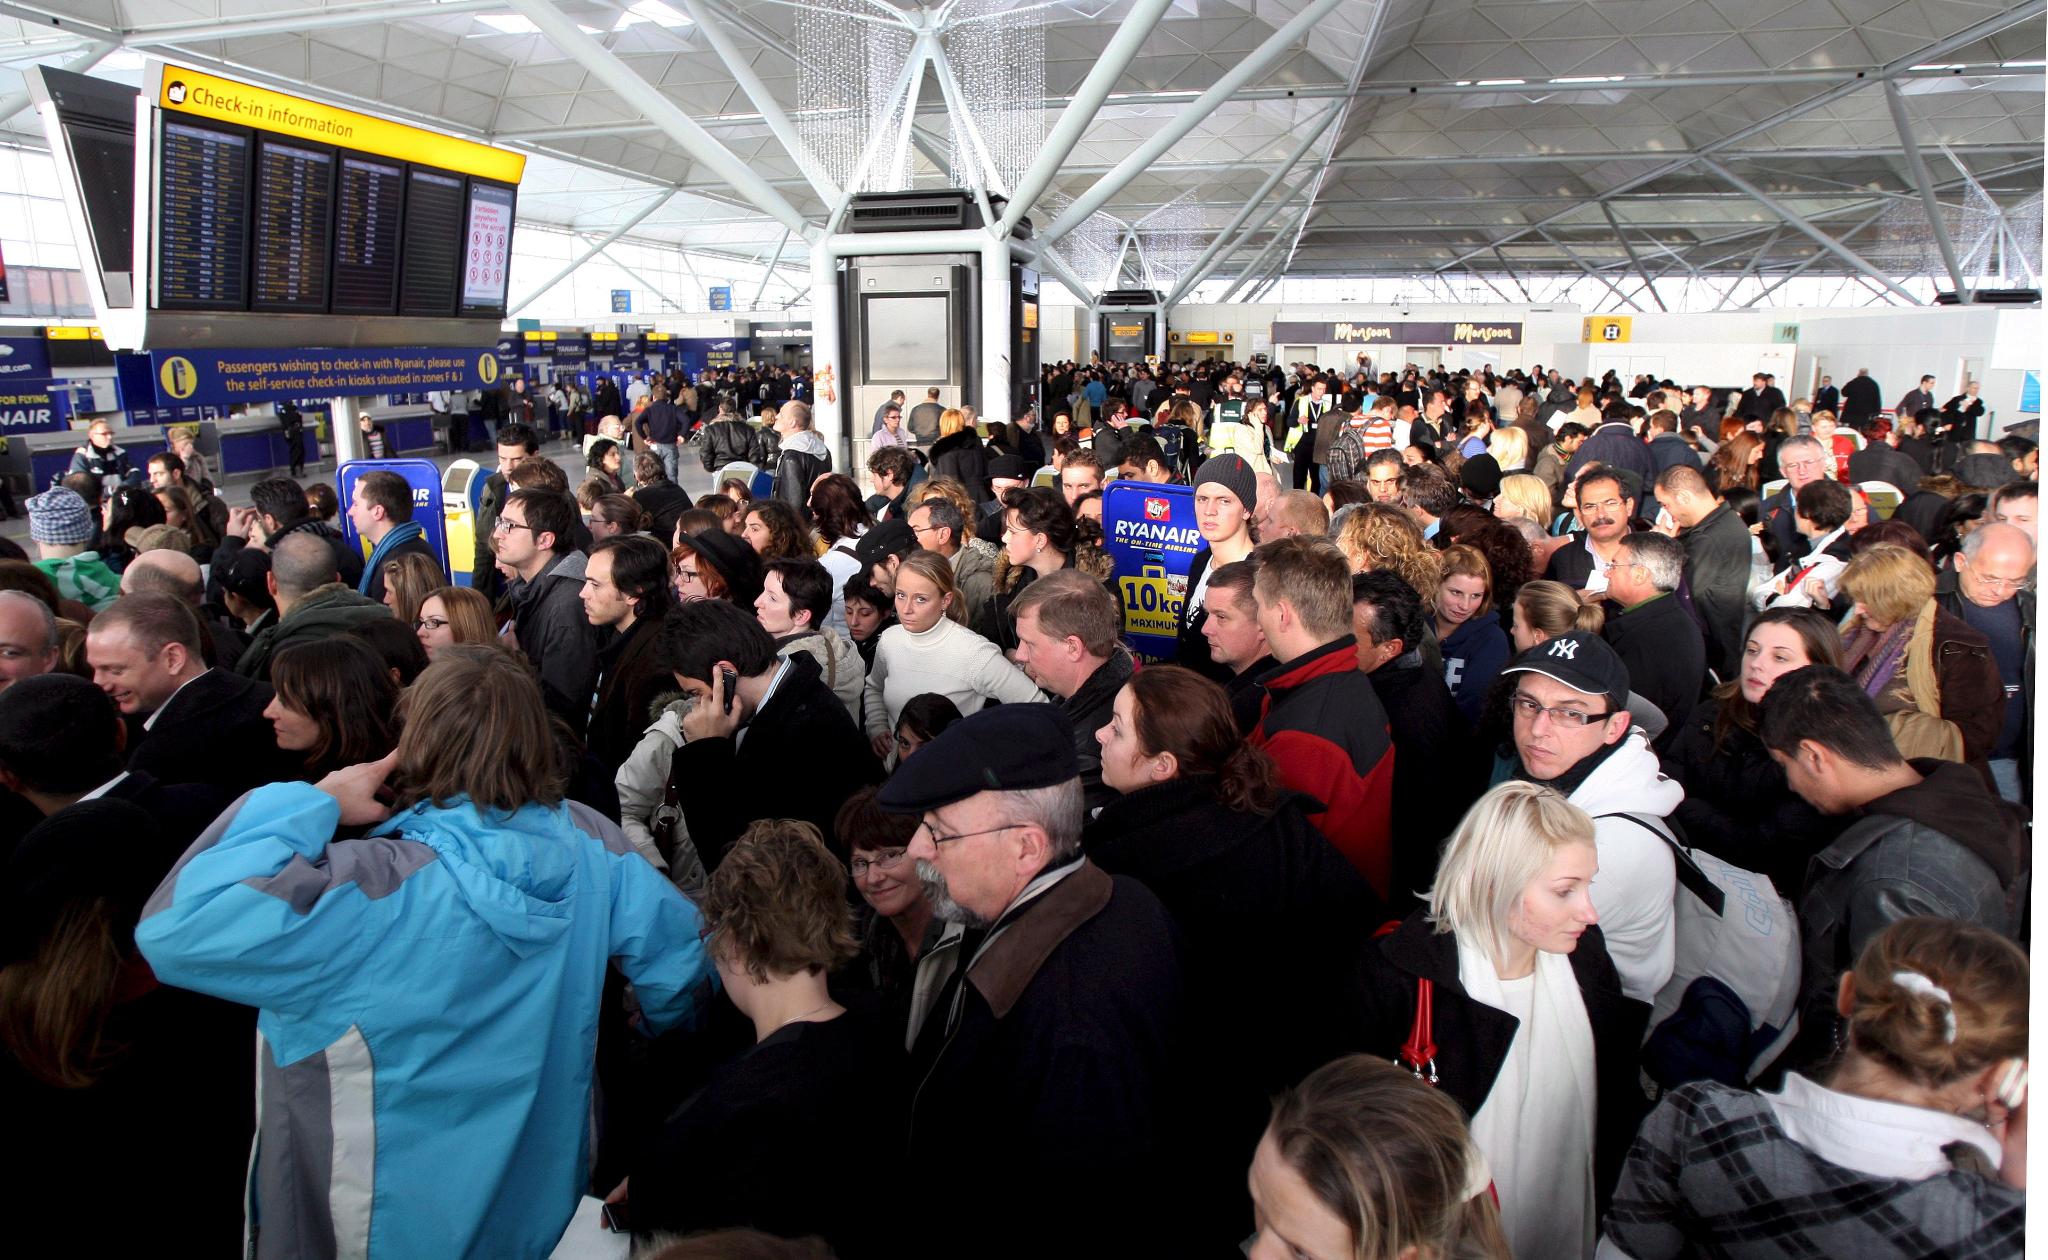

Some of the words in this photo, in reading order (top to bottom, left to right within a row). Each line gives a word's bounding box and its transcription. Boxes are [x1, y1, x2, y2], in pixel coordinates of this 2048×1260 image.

[193, 87, 263, 118] Check-in
[268, 104, 353, 138] information
[1334, 323, 1391, 342] Monsoon
[1454, 323, 1512, 343] Monsoon
[1605, 326, 1619, 339] H
[218, 361, 277, 375] Passengers
[280, 360, 318, 374] wishing
[321, 360, 331, 371] to
[334, 358, 370, 370] check-in
[373, 358, 392, 369] with
[394, 358, 426, 371] Ryanair,
[428, 357, 451, 370] please
[453, 359, 465, 367] use
[226, 379, 245, 391] the
[248, 378, 305, 391] self-service
[308, 377, 346, 388] check-in
[349, 375, 375, 386] kiosks
[377, 374, 410, 385] situated
[411, 373, 420, 383] in
[422, 374, 444, 383] zones
[452, 373, 458, 382] &
[18, 394, 50, 404] FLYING
[1115, 520, 1200, 545] RYANAIR
[1131, 540, 1163, 548] ON-TIME
[1165, 544, 1198, 554] AIRLINE
